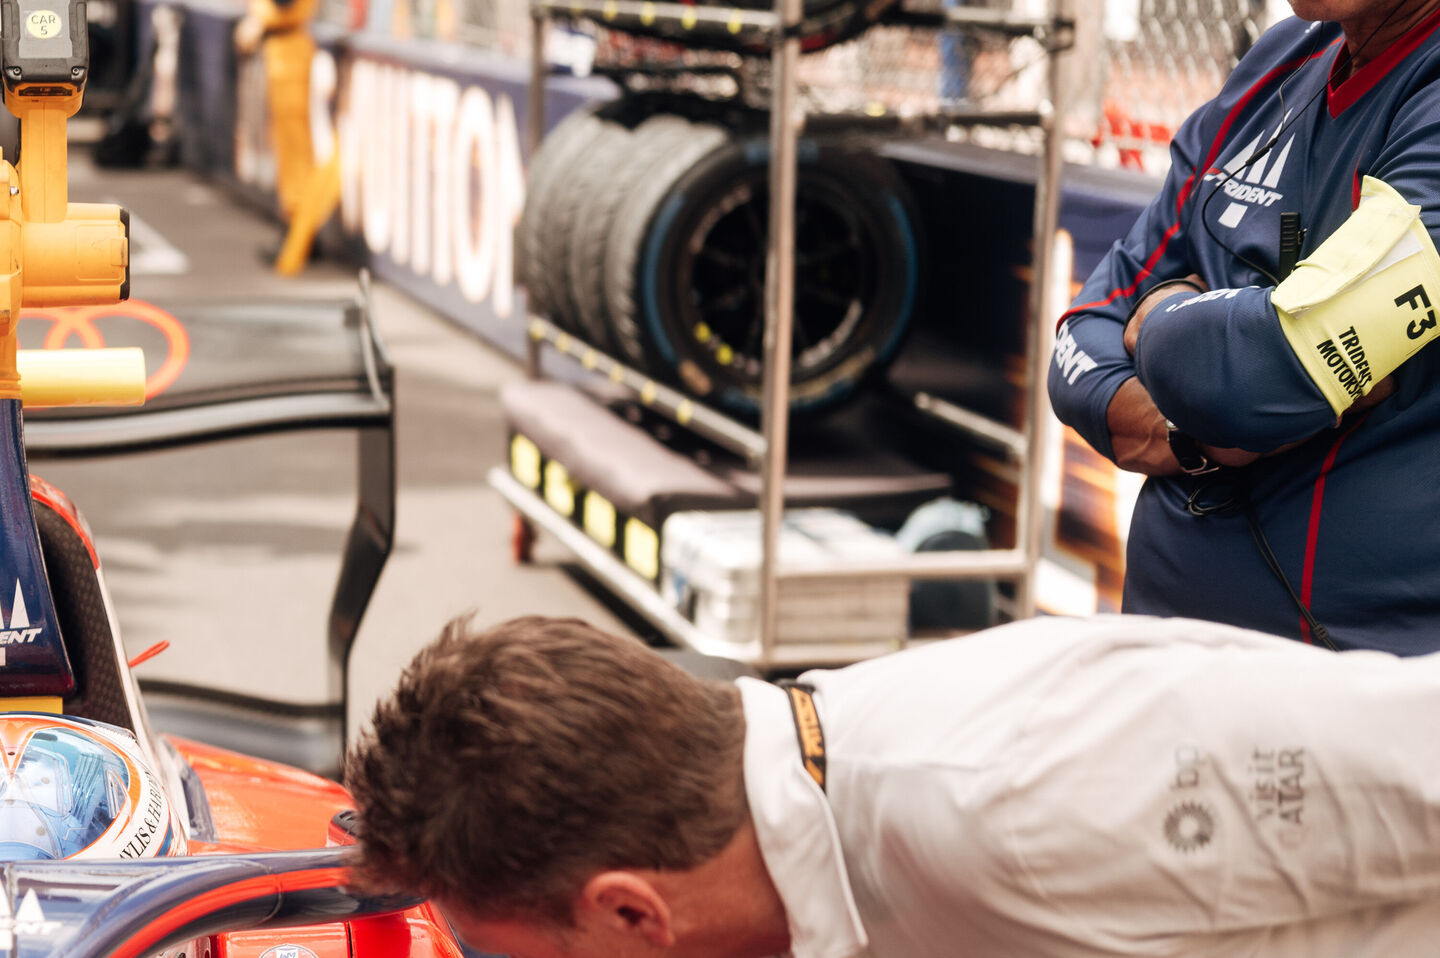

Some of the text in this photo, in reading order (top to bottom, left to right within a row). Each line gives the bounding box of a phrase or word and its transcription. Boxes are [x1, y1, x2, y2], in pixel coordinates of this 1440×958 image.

[31, 14, 56, 25] CAR
[40, 25, 48, 36] 5
[1203, 167, 1283, 207] TRIDENT
[1394, 284, 1438, 340] F3
[1338, 326, 1373, 388] TRIDENT
